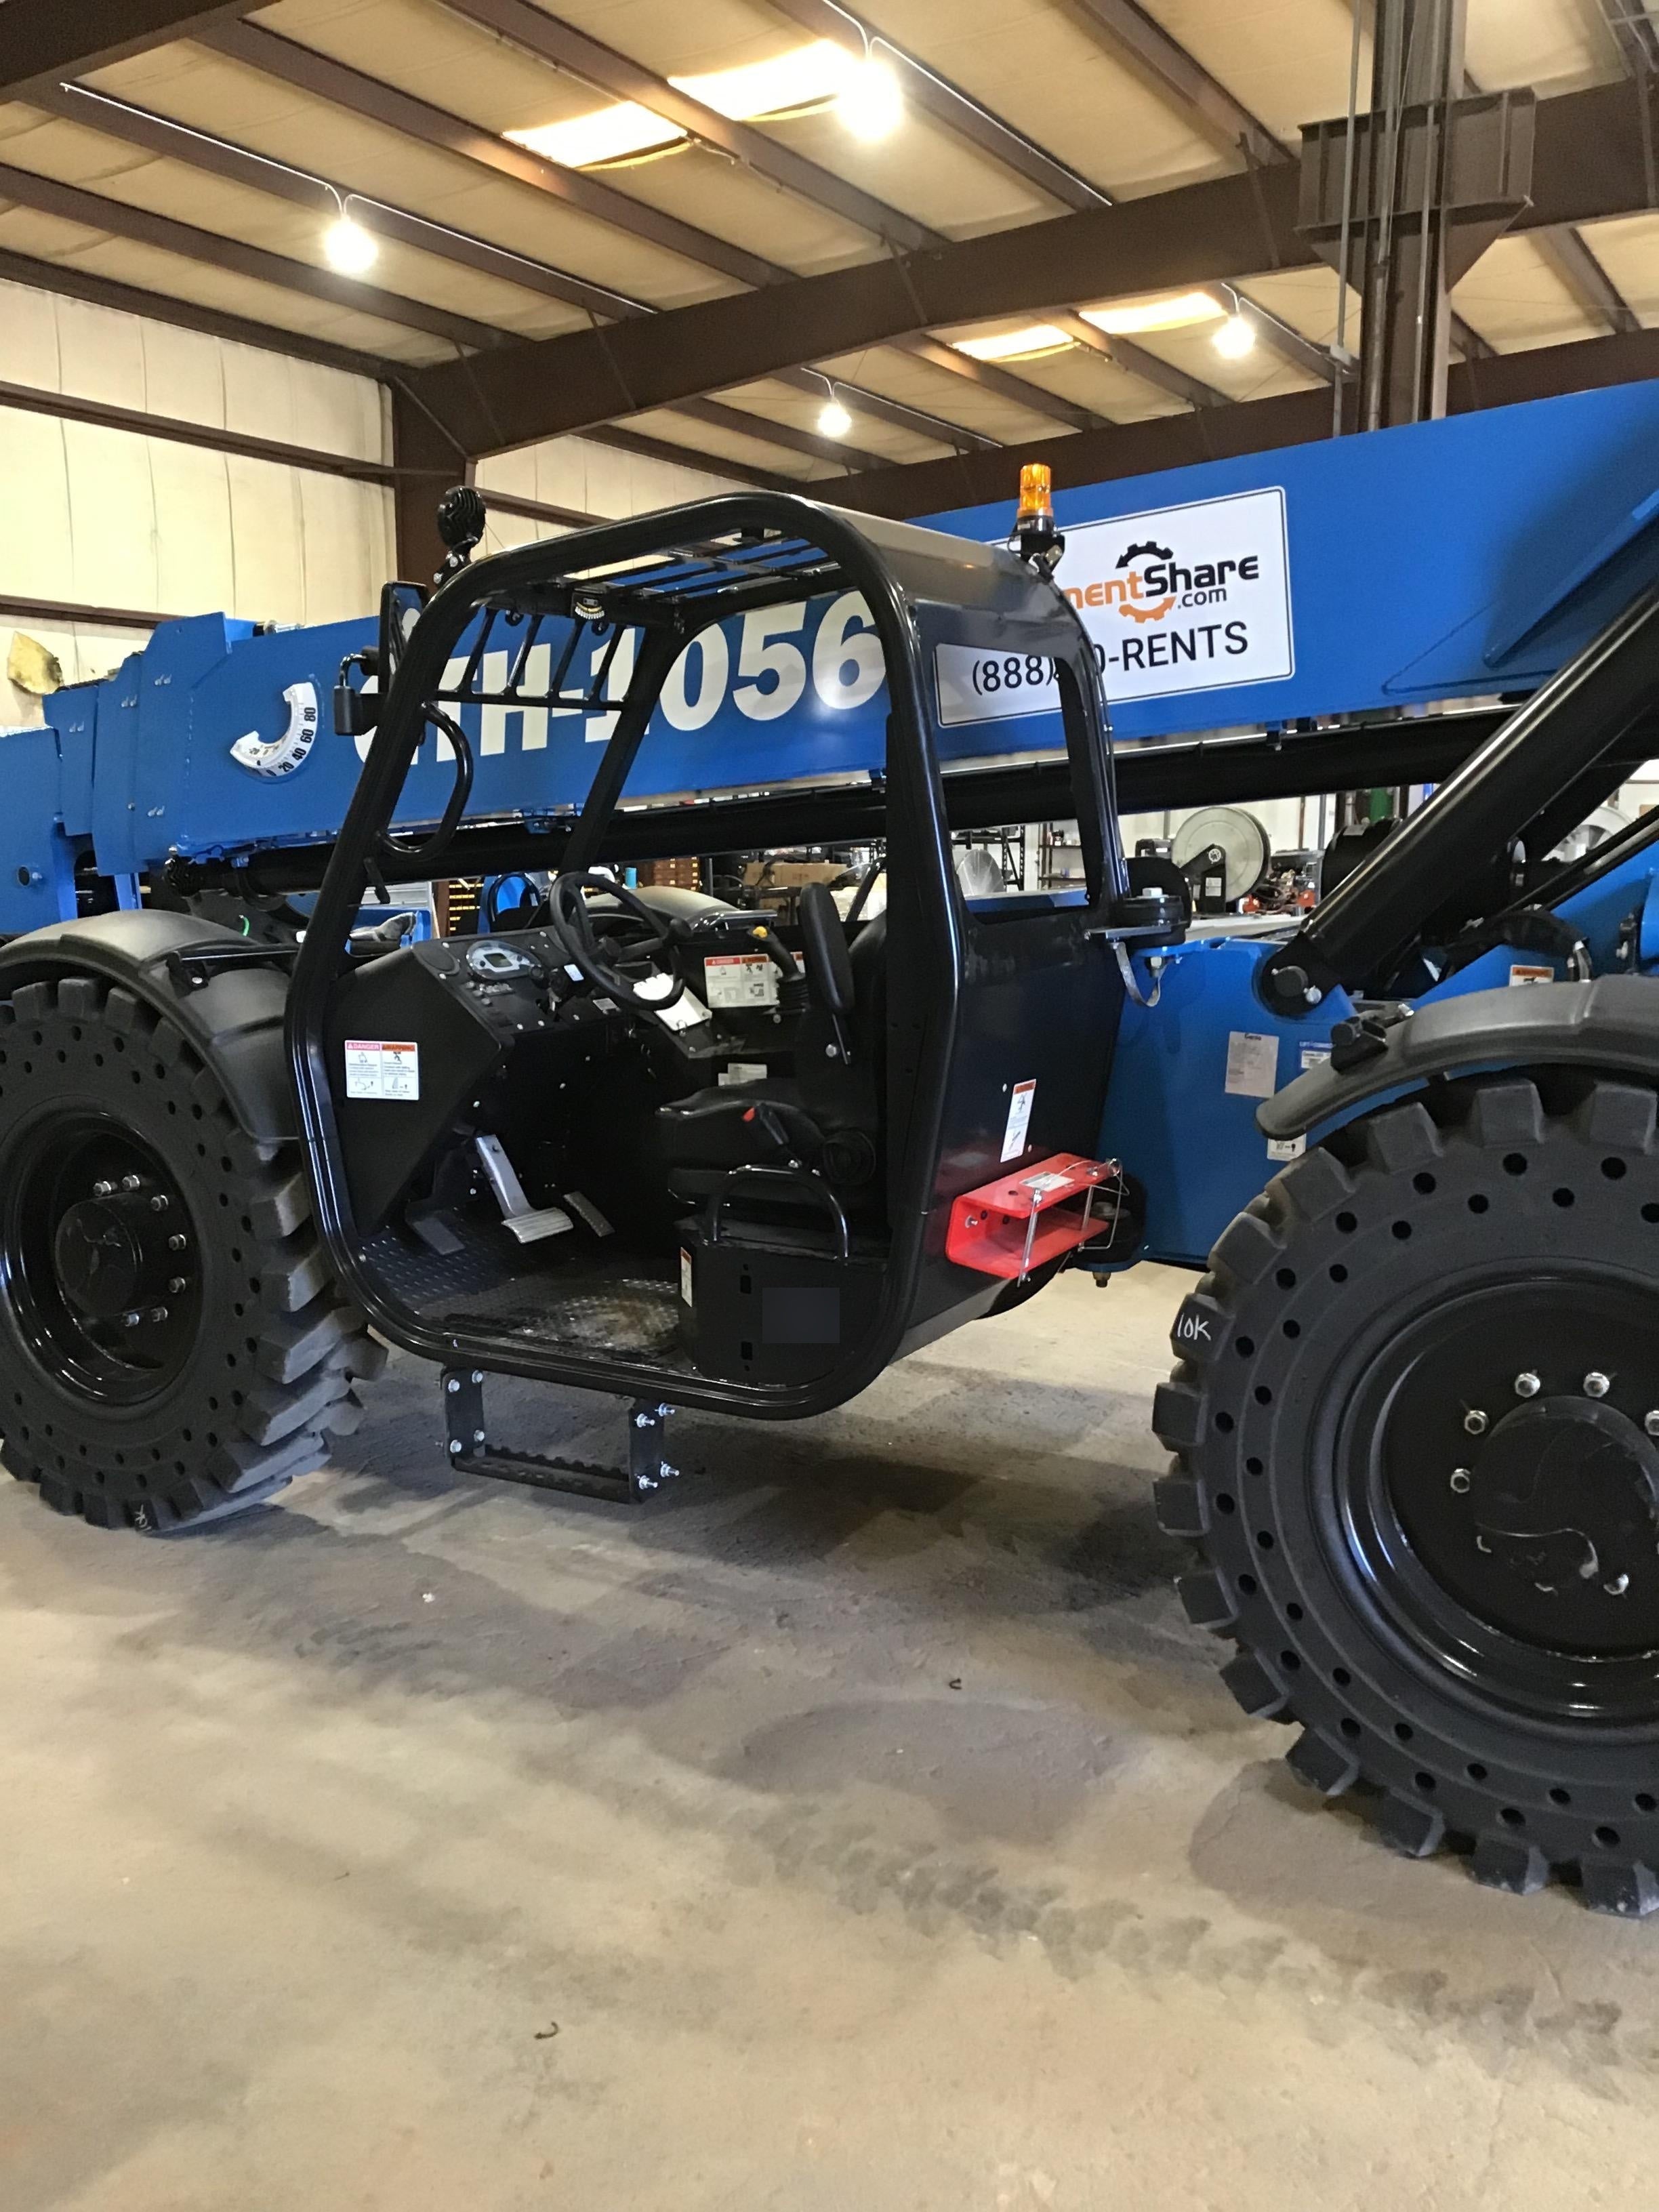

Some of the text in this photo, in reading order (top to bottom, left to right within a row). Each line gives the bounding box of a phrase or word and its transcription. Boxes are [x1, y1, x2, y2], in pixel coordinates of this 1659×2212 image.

[1177, 588, 1227, 609] .com
[972, 655, 1054, 696] (888)
[304, 707, 316, 722] 80
[300, 729, 314, 743] 60
[291, 747, 307, 761] 40
[278, 761, 294, 773] 20
[1176, 1313, 1212, 1341] 10K
